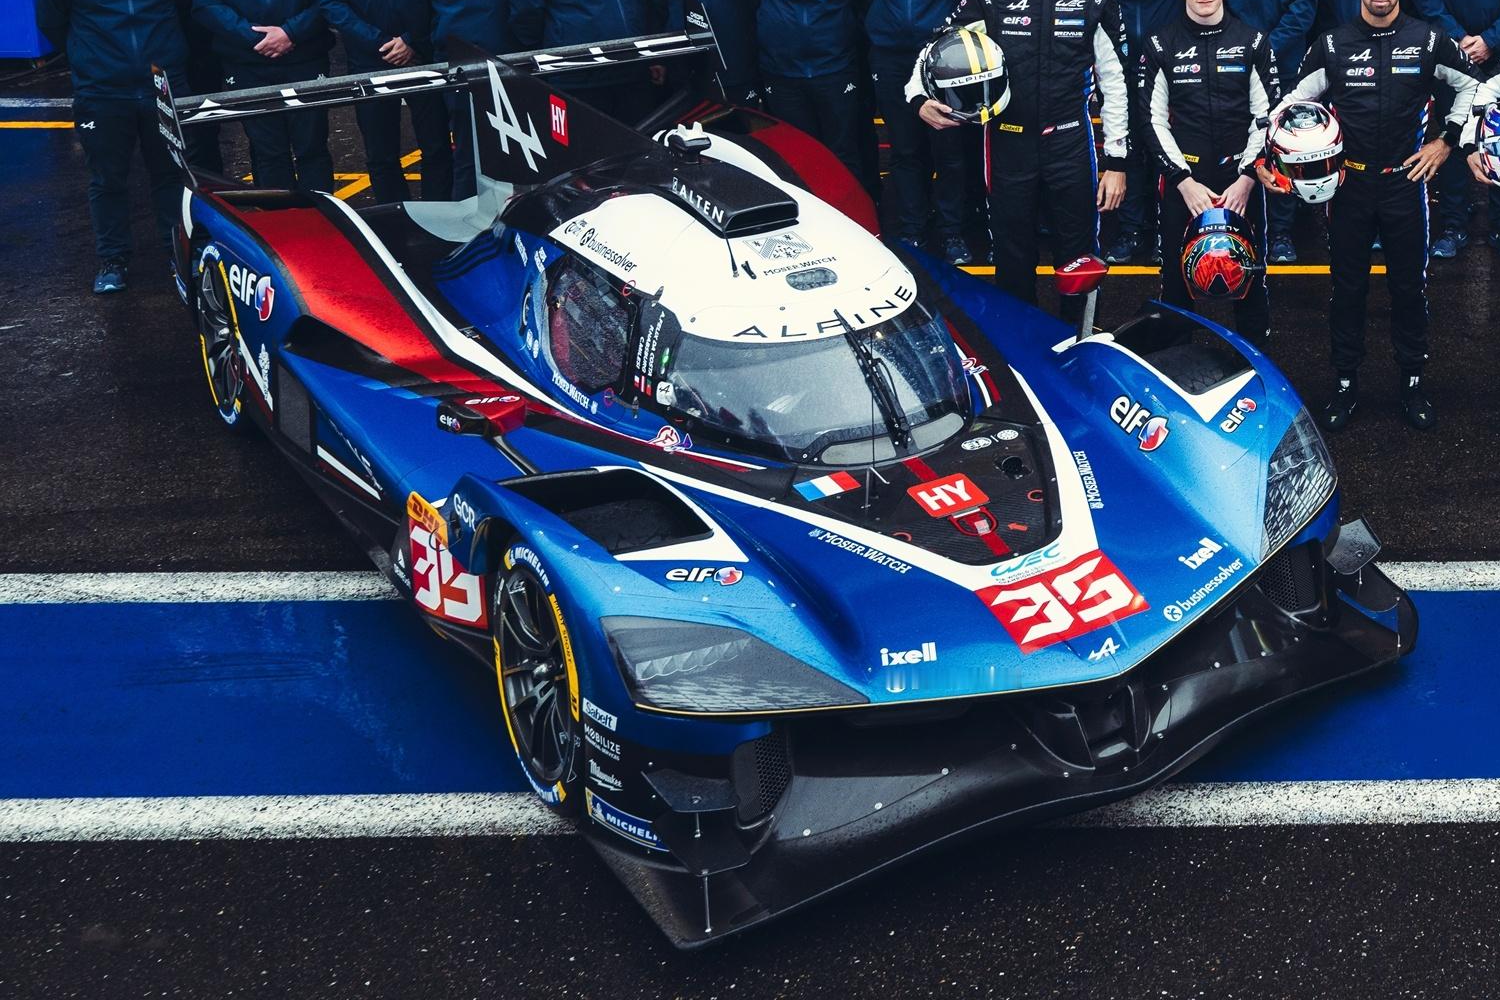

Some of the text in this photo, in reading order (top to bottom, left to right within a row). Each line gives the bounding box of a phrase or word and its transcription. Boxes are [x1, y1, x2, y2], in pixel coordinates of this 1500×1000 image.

[1055, 0, 1086, 7] WEC
[1216, 46, 1245, 54] WEC
[950, 72, 994, 86] ALPINE
[551, 104, 565, 136] HY
[1295, 149, 1336, 162] ALPINE
[679, 184, 725, 224] ALTEN
[1198, 225, 1240, 234] ALPINE
[587, 233, 638, 273] businessolver
[732, 285, 913, 338] ALPINE
[916, 479, 973, 511] HY
[453, 493, 476, 532] GCR
[515, 547, 550, 588] MICHELIN
[818, 530, 912, 575] MOSER.WATCH
[990, 543, 1061, 577] WEC
[1178, 536, 1223, 570] ixell
[410, 526, 482, 622] 35
[666, 567, 714, 583] elf
[1179, 557, 1245, 610] businessolver
[990, 556, 1134, 645] 35
[880, 642, 937, 666] ixell
[585, 702, 614, 728] Sabelt
